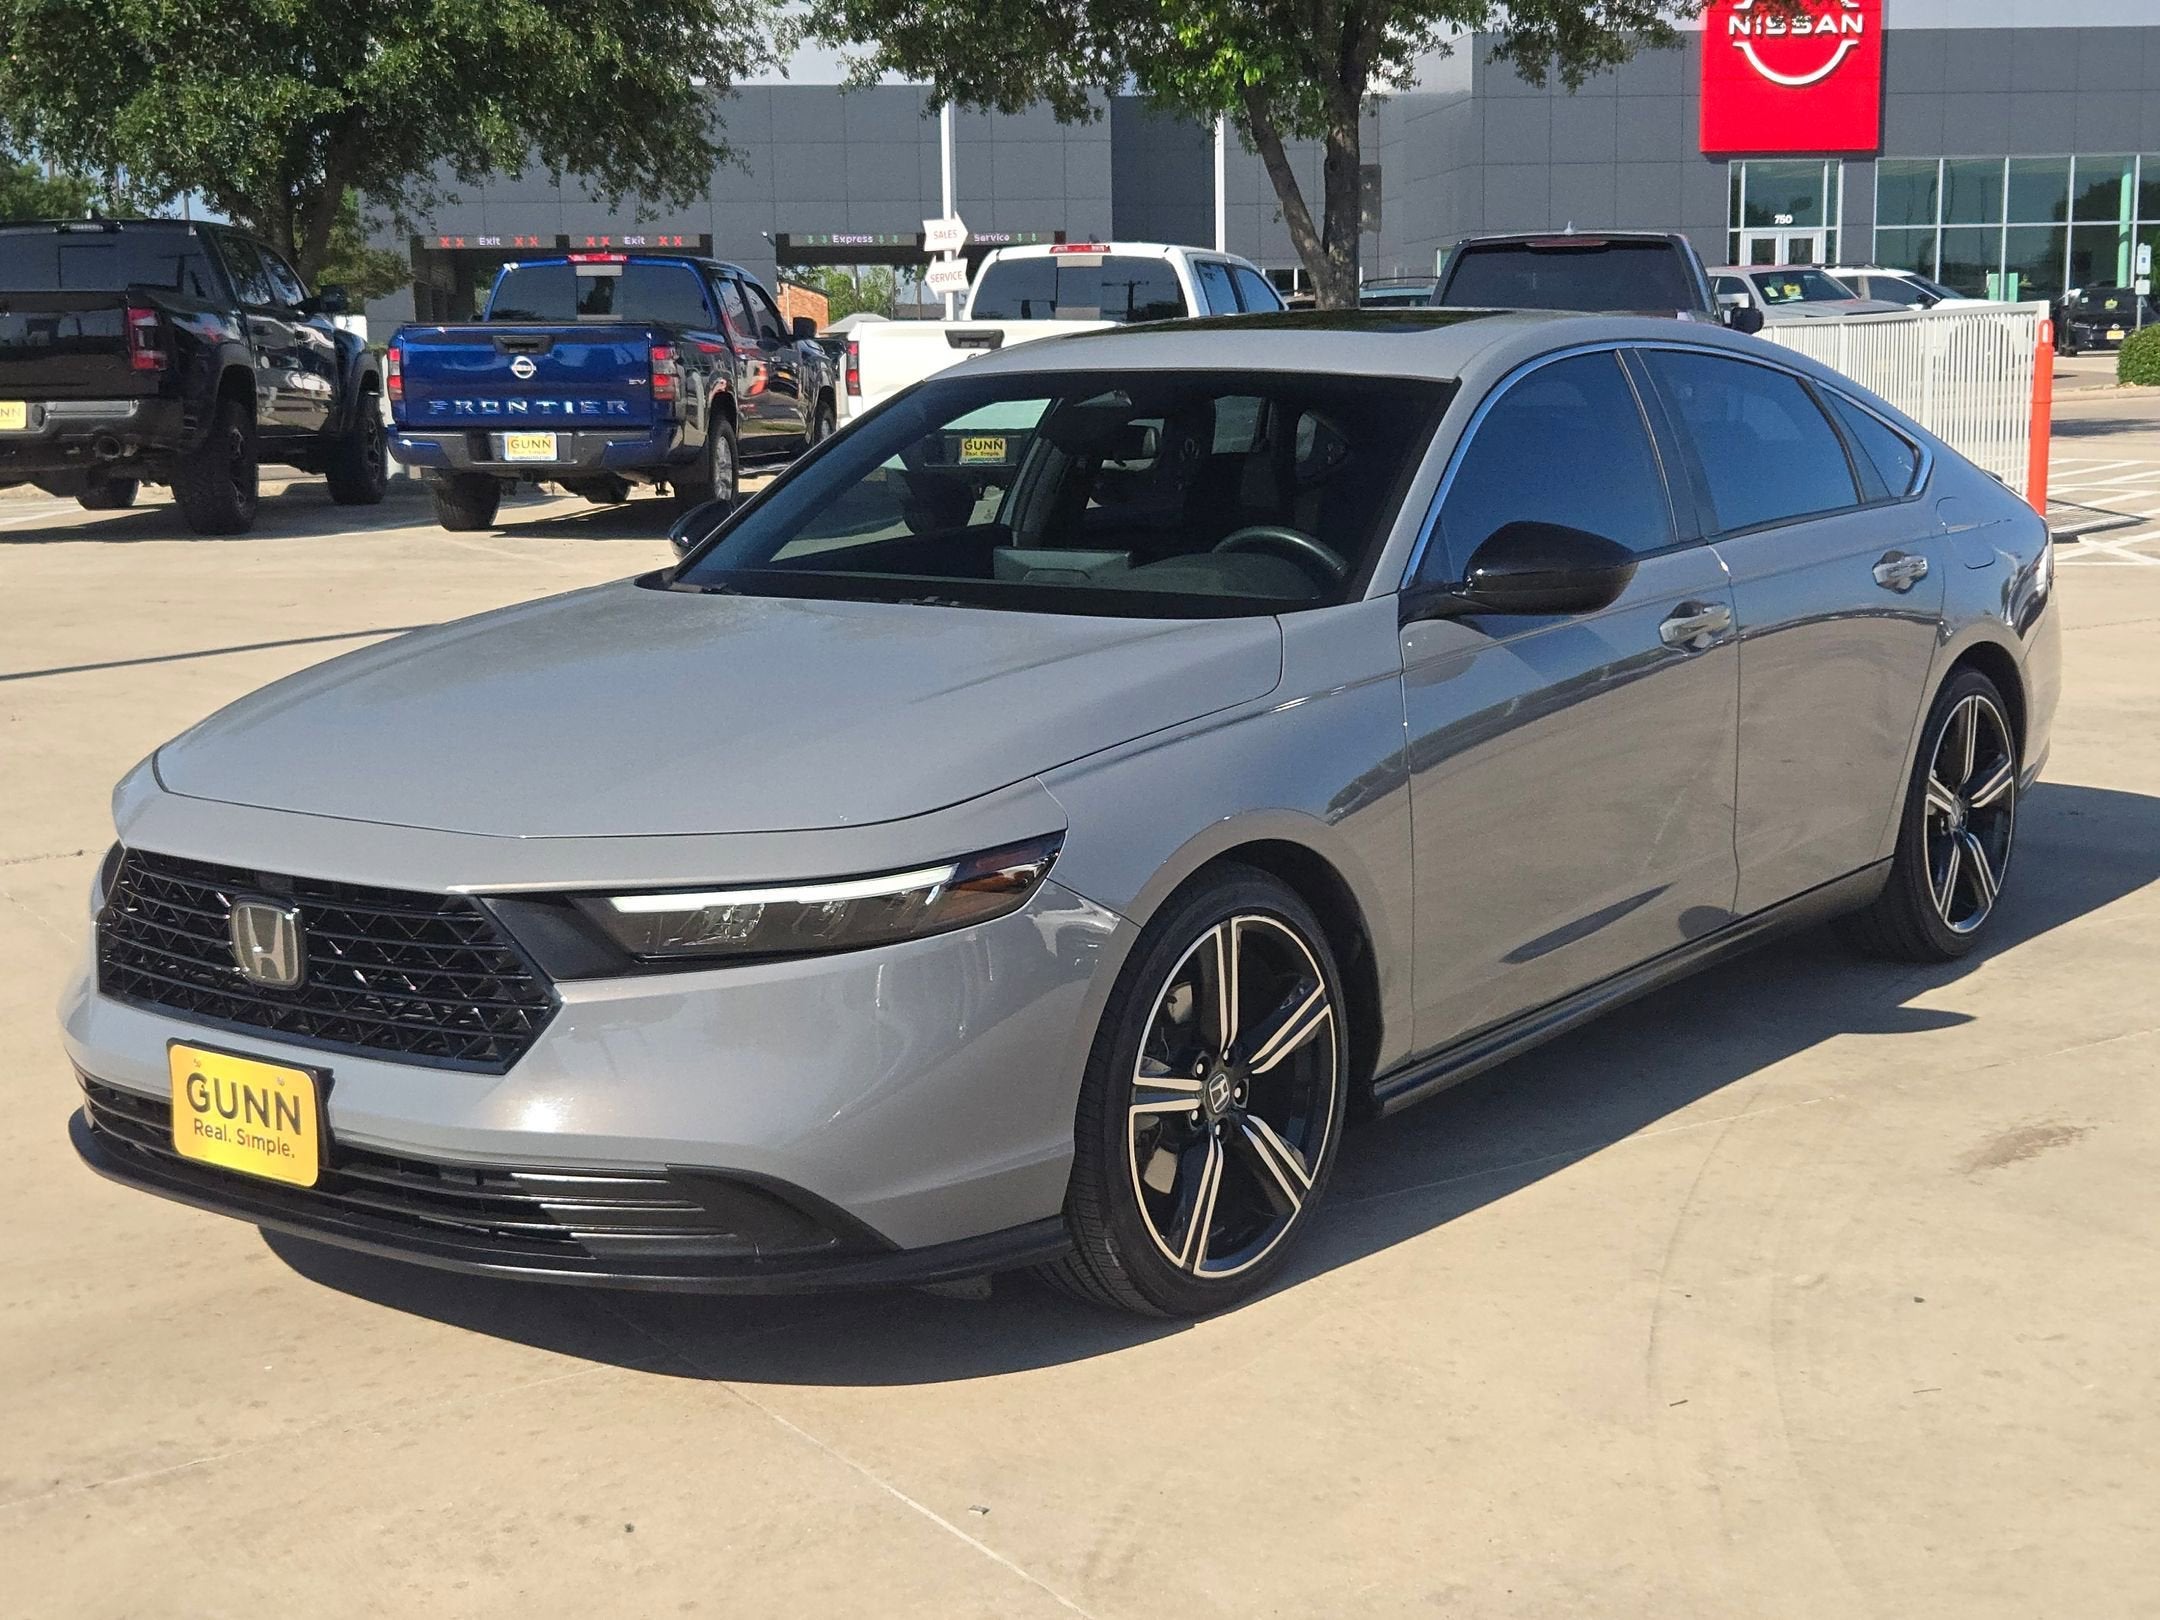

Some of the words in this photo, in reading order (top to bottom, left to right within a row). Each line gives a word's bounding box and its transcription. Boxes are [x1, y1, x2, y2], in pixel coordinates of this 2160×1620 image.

[1728, 13, 1864, 36] NISSAN
[623, 235, 646, 245] Exit
[832, 234, 874, 245] Express
[933, 229, 959, 240] SALES
[479, 236, 501, 246] Exit
[929, 270, 963, 284] SERVICE
[428, 399, 630, 415] FRONTIER
[510, 439, 552, 449] GUNN
[964, 440, 1003, 451] GUNN
[186, 1071, 302, 1137] GUNN
[193, 1117, 232, 1143] Real.
